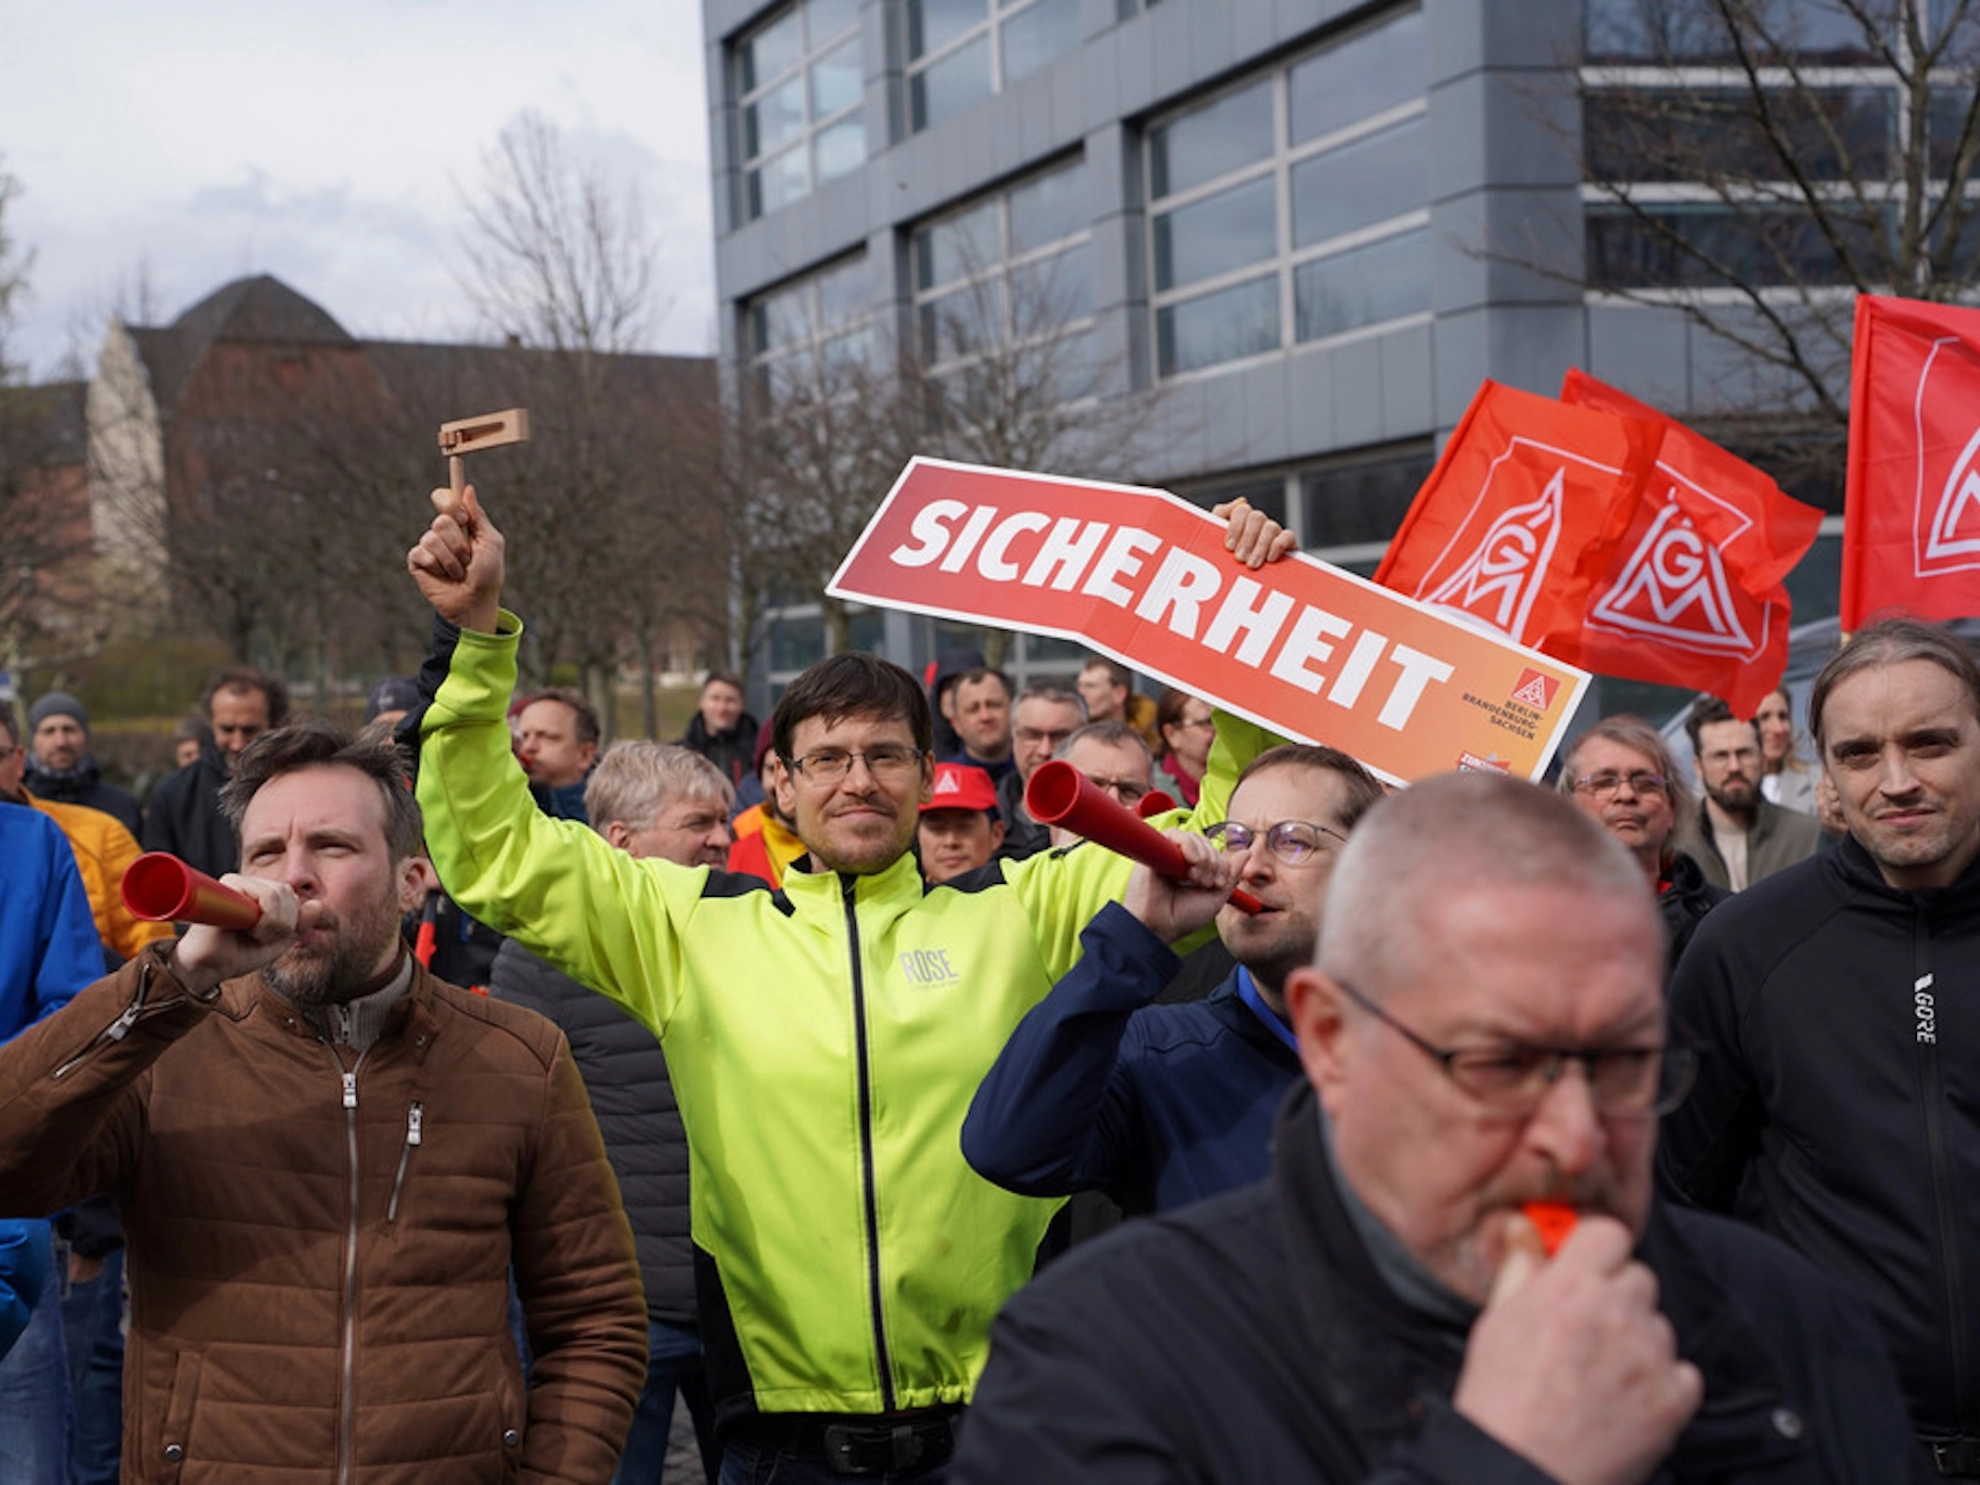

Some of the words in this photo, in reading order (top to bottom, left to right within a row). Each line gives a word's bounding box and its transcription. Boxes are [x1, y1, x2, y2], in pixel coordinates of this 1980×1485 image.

[890, 499, 1454, 731] SICHERHEIT
[1462, 693, 1538, 729] BRANDENBURG-
[1490, 715, 1536, 740] SACHSEN
[1505, 700, 1544, 721] BERLIN-
[899, 949, 959, 984] ROSE
[1914, 992, 1937, 1045] GORE
